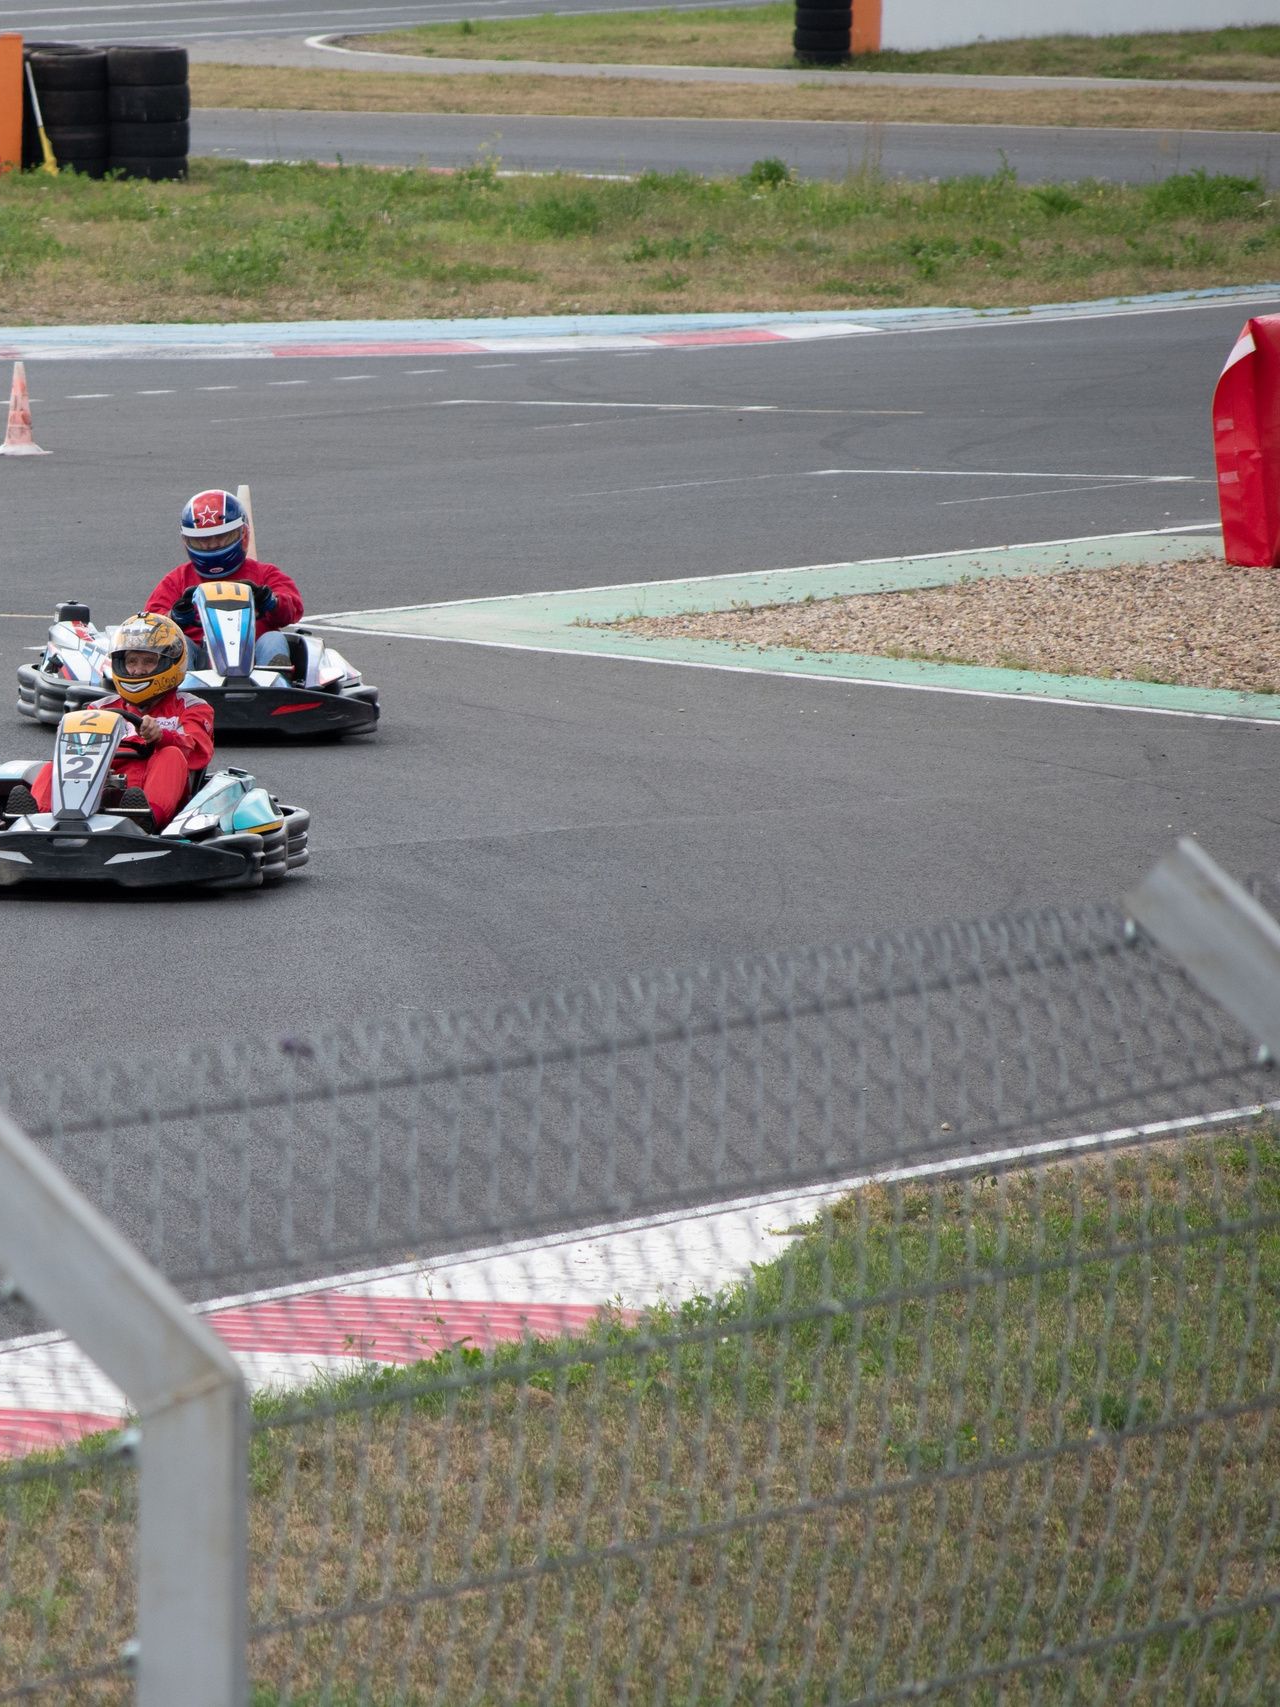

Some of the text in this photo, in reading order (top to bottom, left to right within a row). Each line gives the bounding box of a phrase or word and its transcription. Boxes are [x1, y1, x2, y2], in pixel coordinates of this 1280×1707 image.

[212, 583, 241, 595] 11
[80, 711, 100, 726] 2
[63, 757, 94, 779] 2
